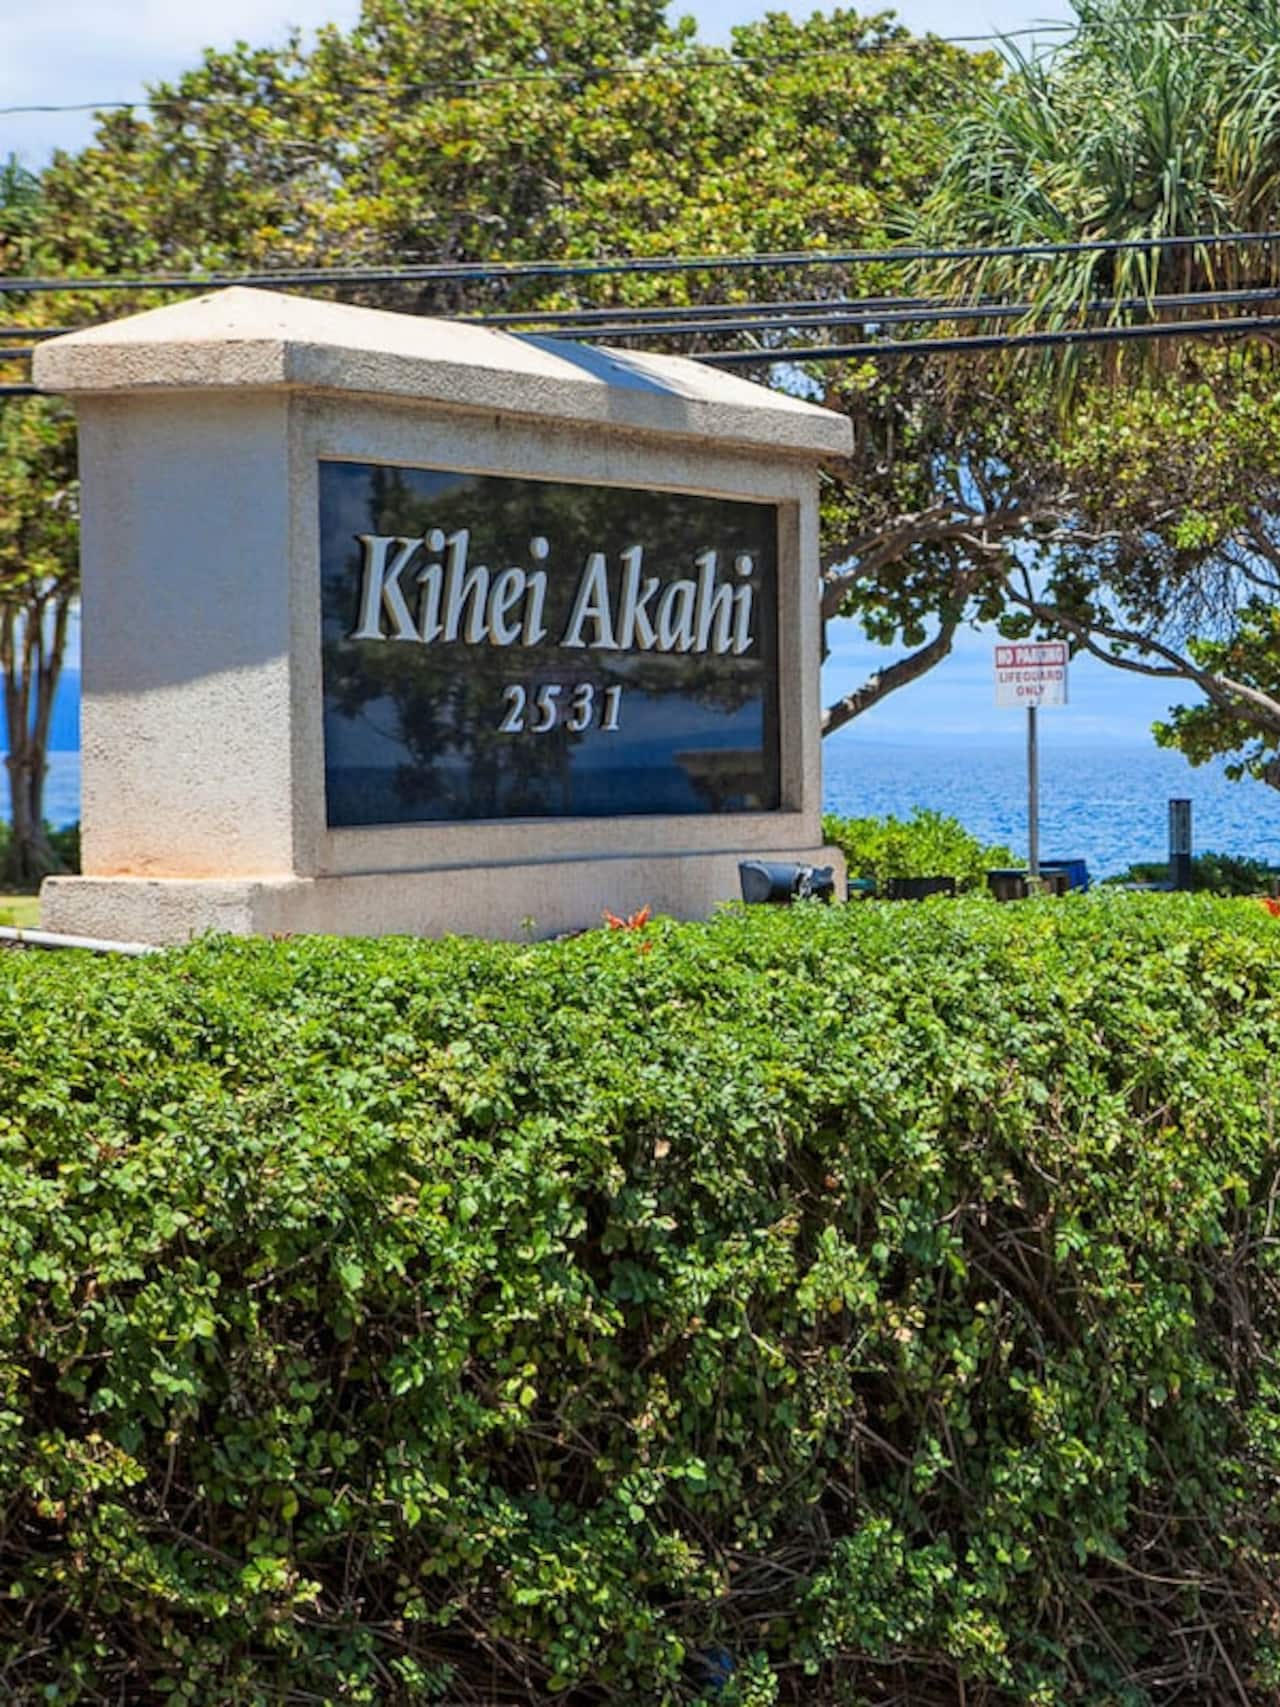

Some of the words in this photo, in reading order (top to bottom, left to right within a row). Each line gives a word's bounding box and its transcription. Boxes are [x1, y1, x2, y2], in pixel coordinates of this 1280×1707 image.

[351, 527, 550, 646] Kihei
[560, 545, 754, 655] Akahi
[1000, 670, 1063, 683] LIFEGUARD
[1016, 685, 1045, 697] ONLY
[500, 683, 622, 733] 2531
